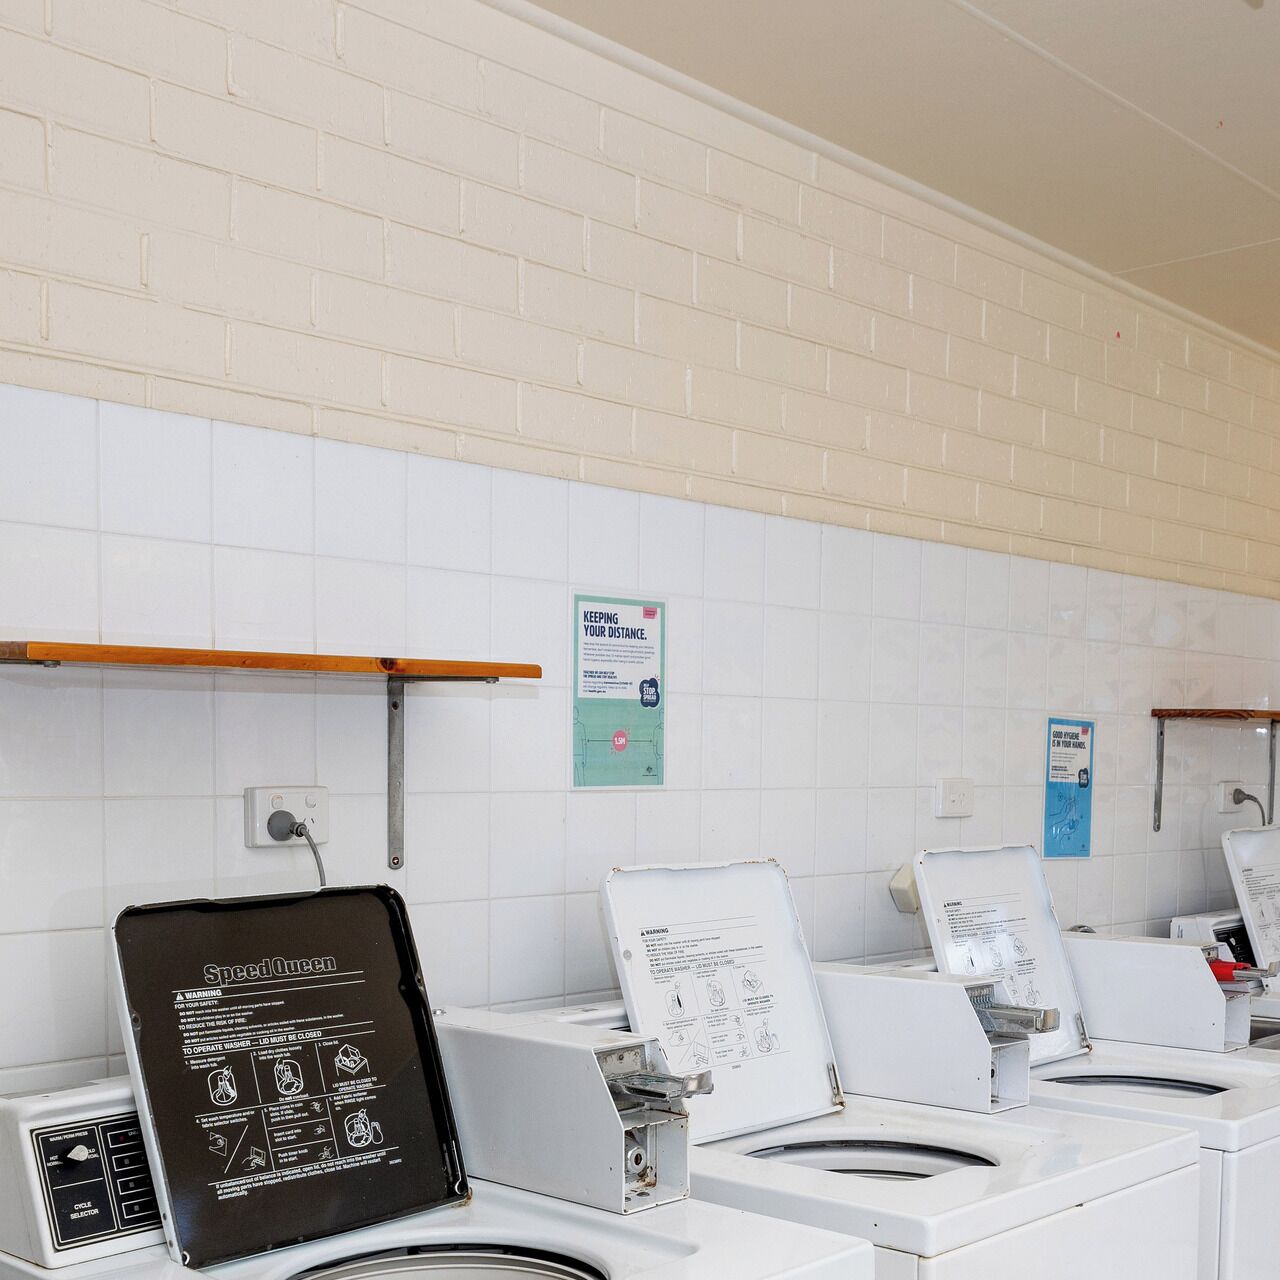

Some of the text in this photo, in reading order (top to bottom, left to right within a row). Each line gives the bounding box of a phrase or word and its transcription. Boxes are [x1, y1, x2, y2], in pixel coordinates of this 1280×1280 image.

[584, 611, 618, 625] KEEPING
[584, 624, 647, 640] YOUR DISTANCE.
[1052, 730, 1080, 740] GOOD HYGIENE
[185, 989, 222, 999] WARNING
[193, 1043, 222, 1052] OPERATE
[223, 1040, 250, 1048] WASHER
[259, 1037, 269, 1046] LID
[270, 1035, 286, 1045] MUST
[288, 1033, 296, 1043] BE
[297, 1030, 321, 1041] CLOSED
[74, 1202, 92, 1210] CYCLE
[70, 1208, 99, 1220] SELECTOR
